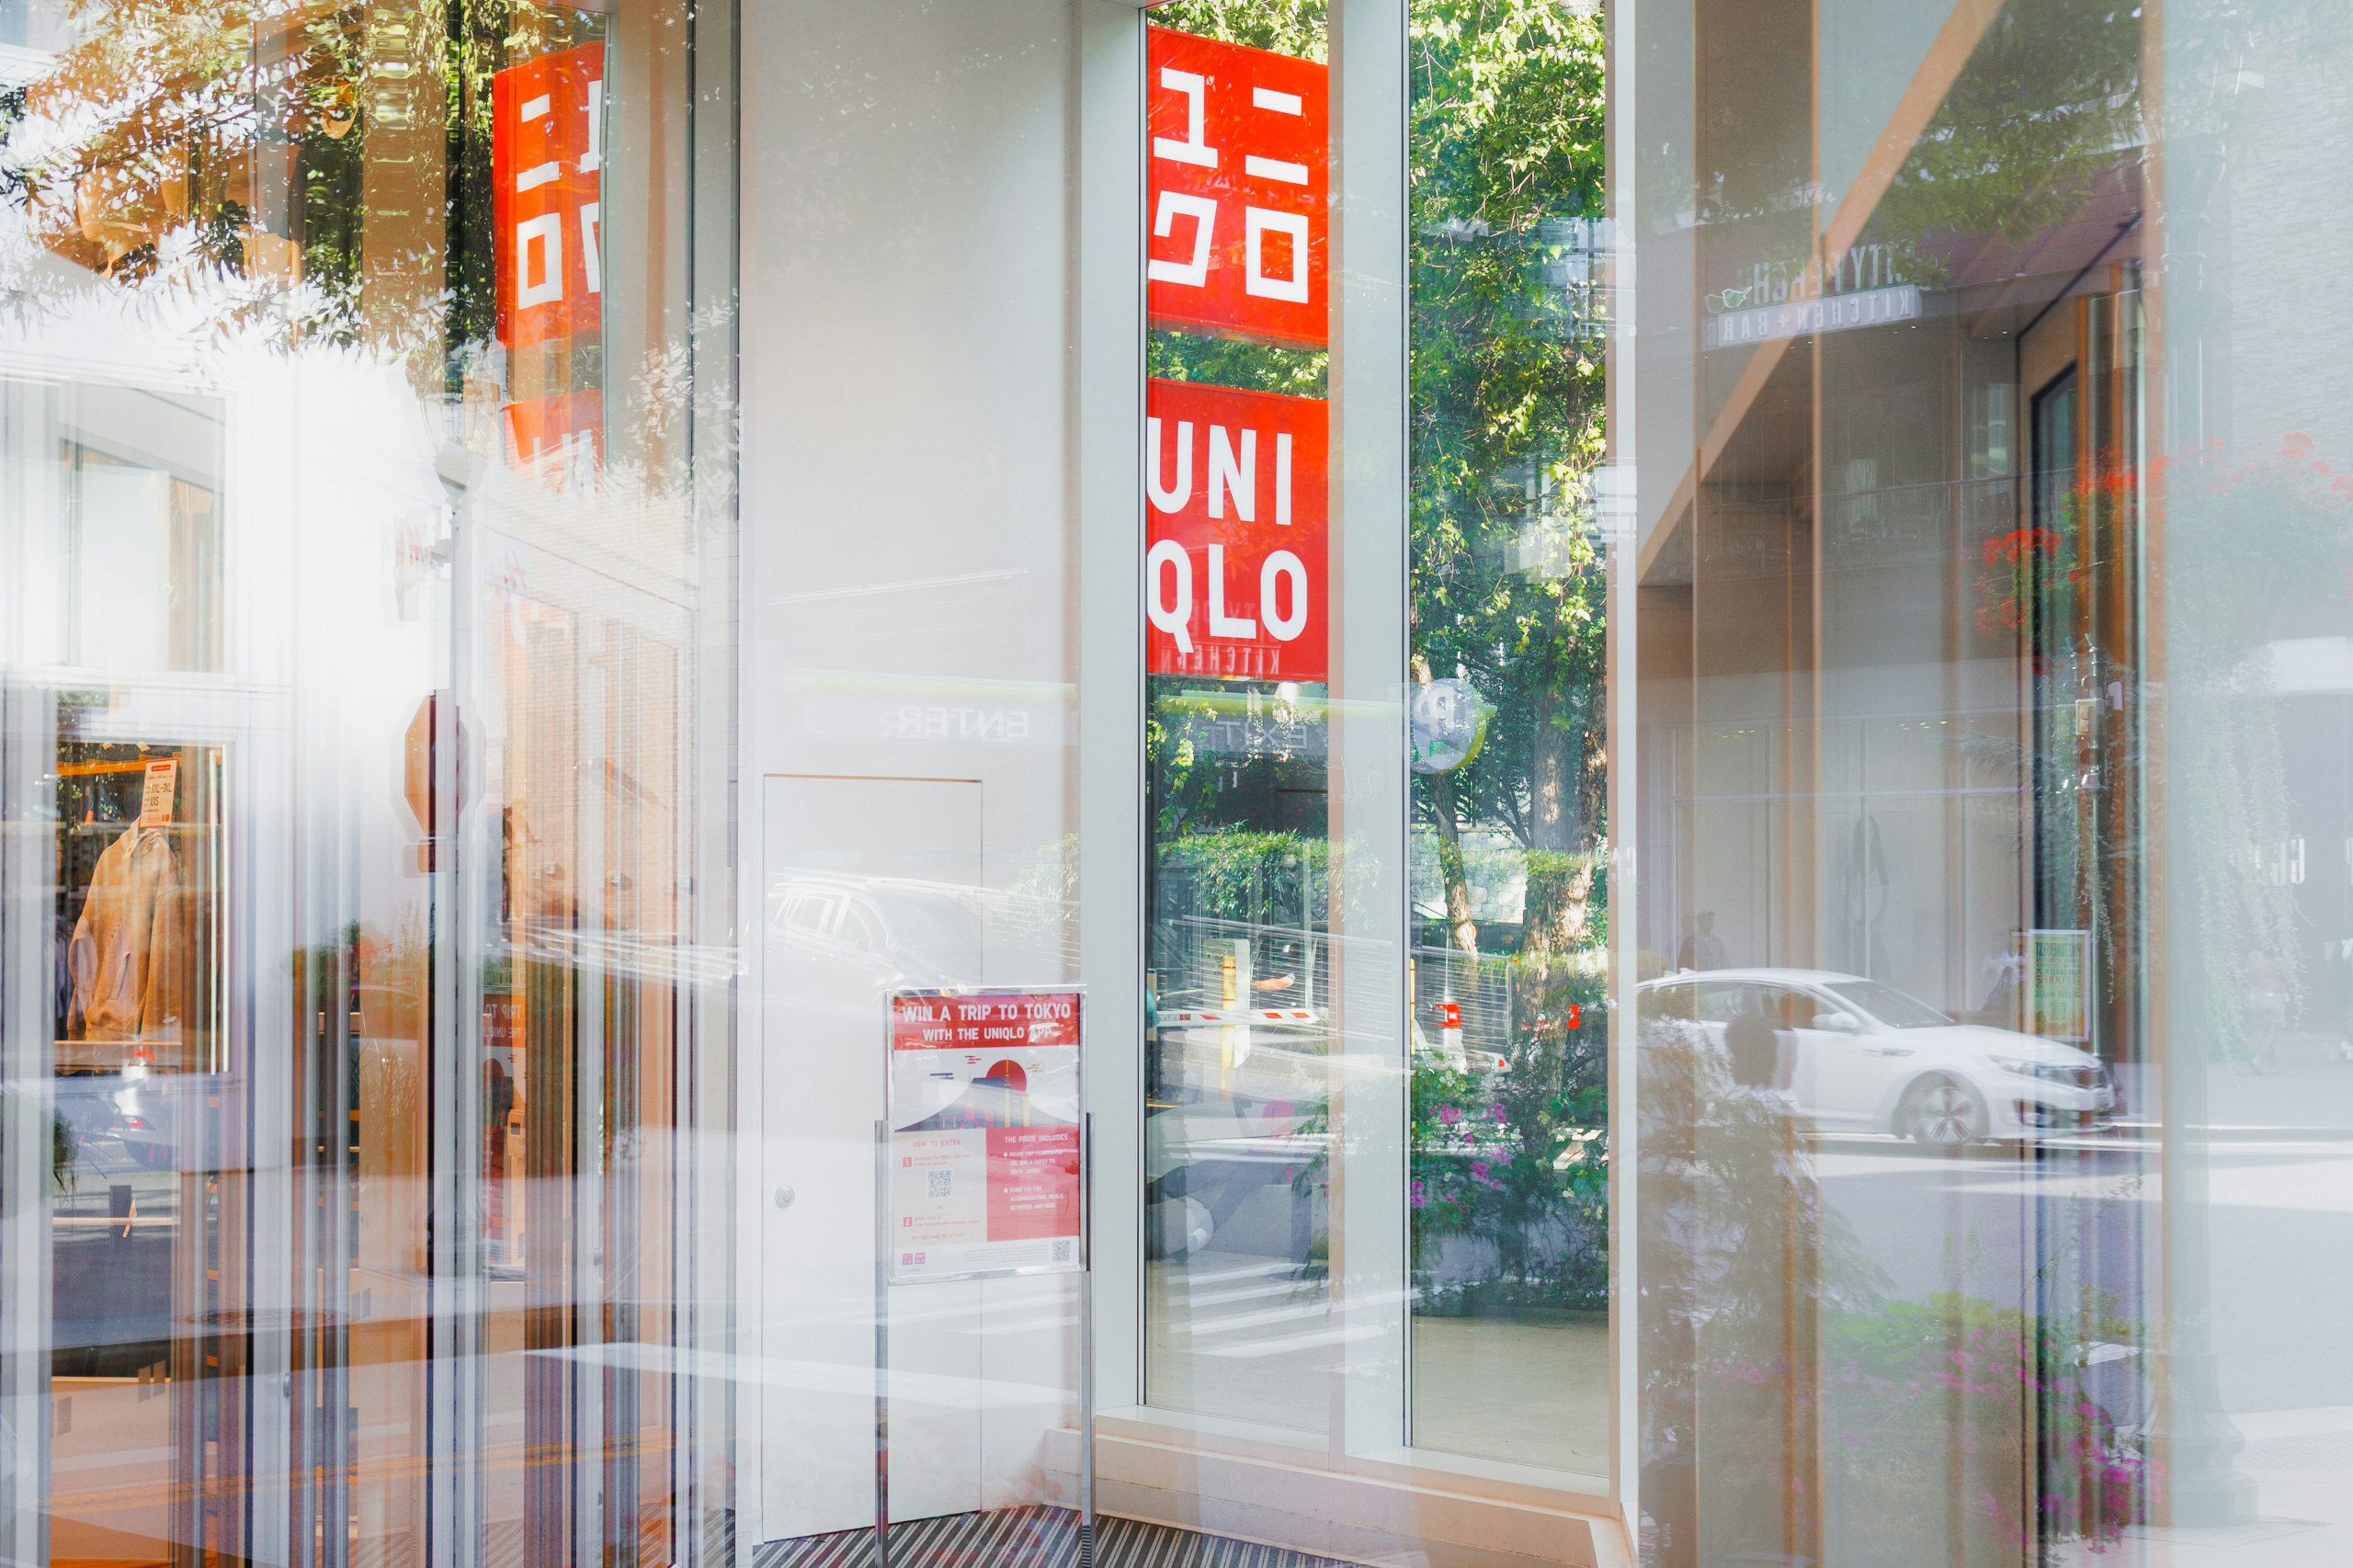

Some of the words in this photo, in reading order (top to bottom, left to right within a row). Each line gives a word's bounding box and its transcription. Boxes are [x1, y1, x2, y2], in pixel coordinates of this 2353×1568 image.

[1154, 67, 1308, 186] ユニ
[1148, 190, 1309, 303] クロ
[1147, 416, 1292, 526] UNI
[1147, 539, 1308, 653] QLO
[903, 1006, 933, 1022] WIN
[940, 1006, 951, 1020] A
[958, 1005, 991, 1020] TRIP
[998, 1004, 1017, 1019] TO
[1024, 1003, 1071, 1018] TOKYO
[923, 1028, 952, 1041] WITH
[957, 1028, 979, 1040] THE
[983, 1027, 1025, 1040] UNIQLO
